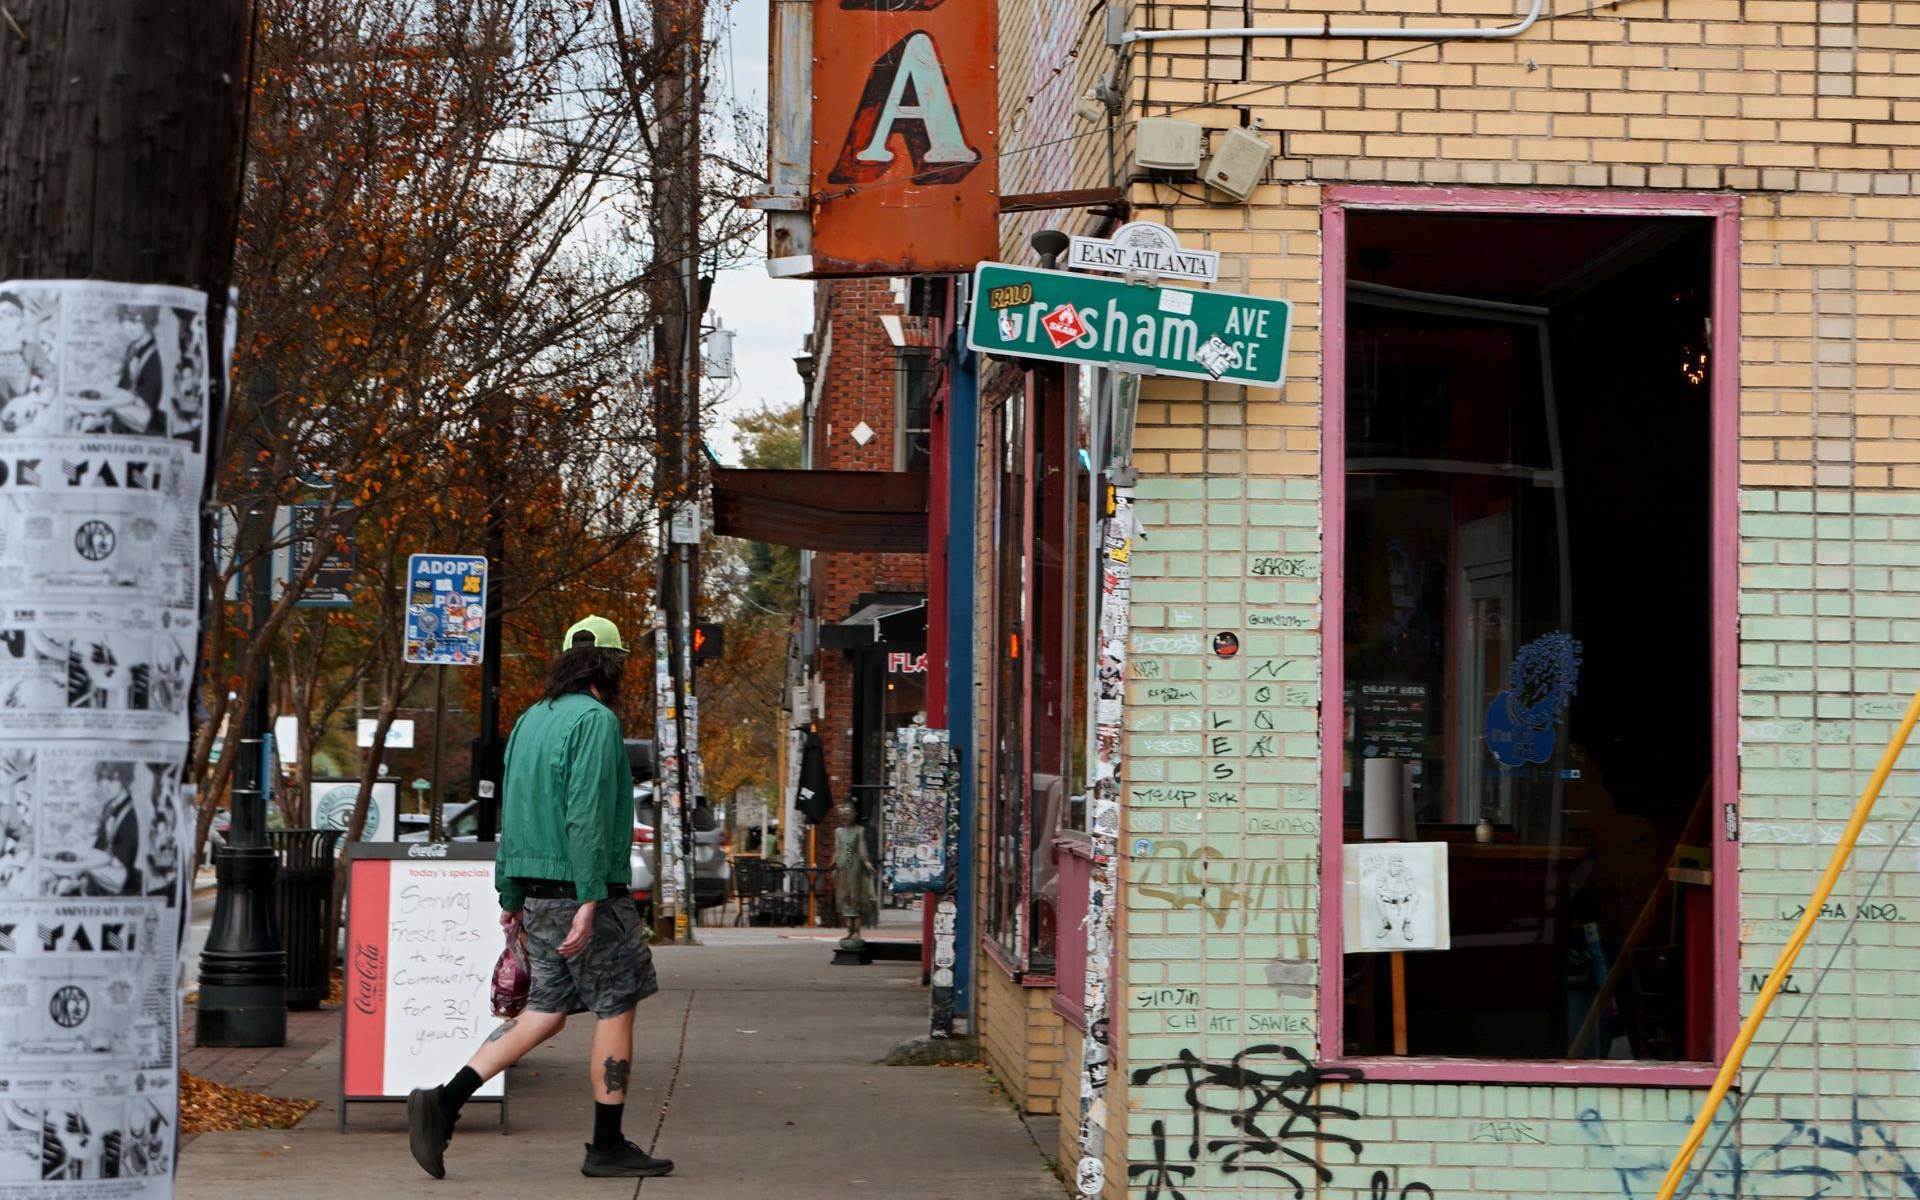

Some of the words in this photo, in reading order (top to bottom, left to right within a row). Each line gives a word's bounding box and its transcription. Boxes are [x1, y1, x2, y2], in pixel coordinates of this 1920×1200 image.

[857, 33, 977, 162] A
[1081, 243, 1125, 267] EAST
[1130, 249, 1208, 276] ATLANTA
[998, 297, 1200, 362] Grsham
[1224, 306, 1270, 339] AVE
[1231, 341, 1260, 372] SE
[409, 867, 447, 878] today's
[449, 868, 490, 878] specials
[409, 950, 427, 962] to
[437, 949, 466, 966] the
[443, 999, 471, 1017] 30
